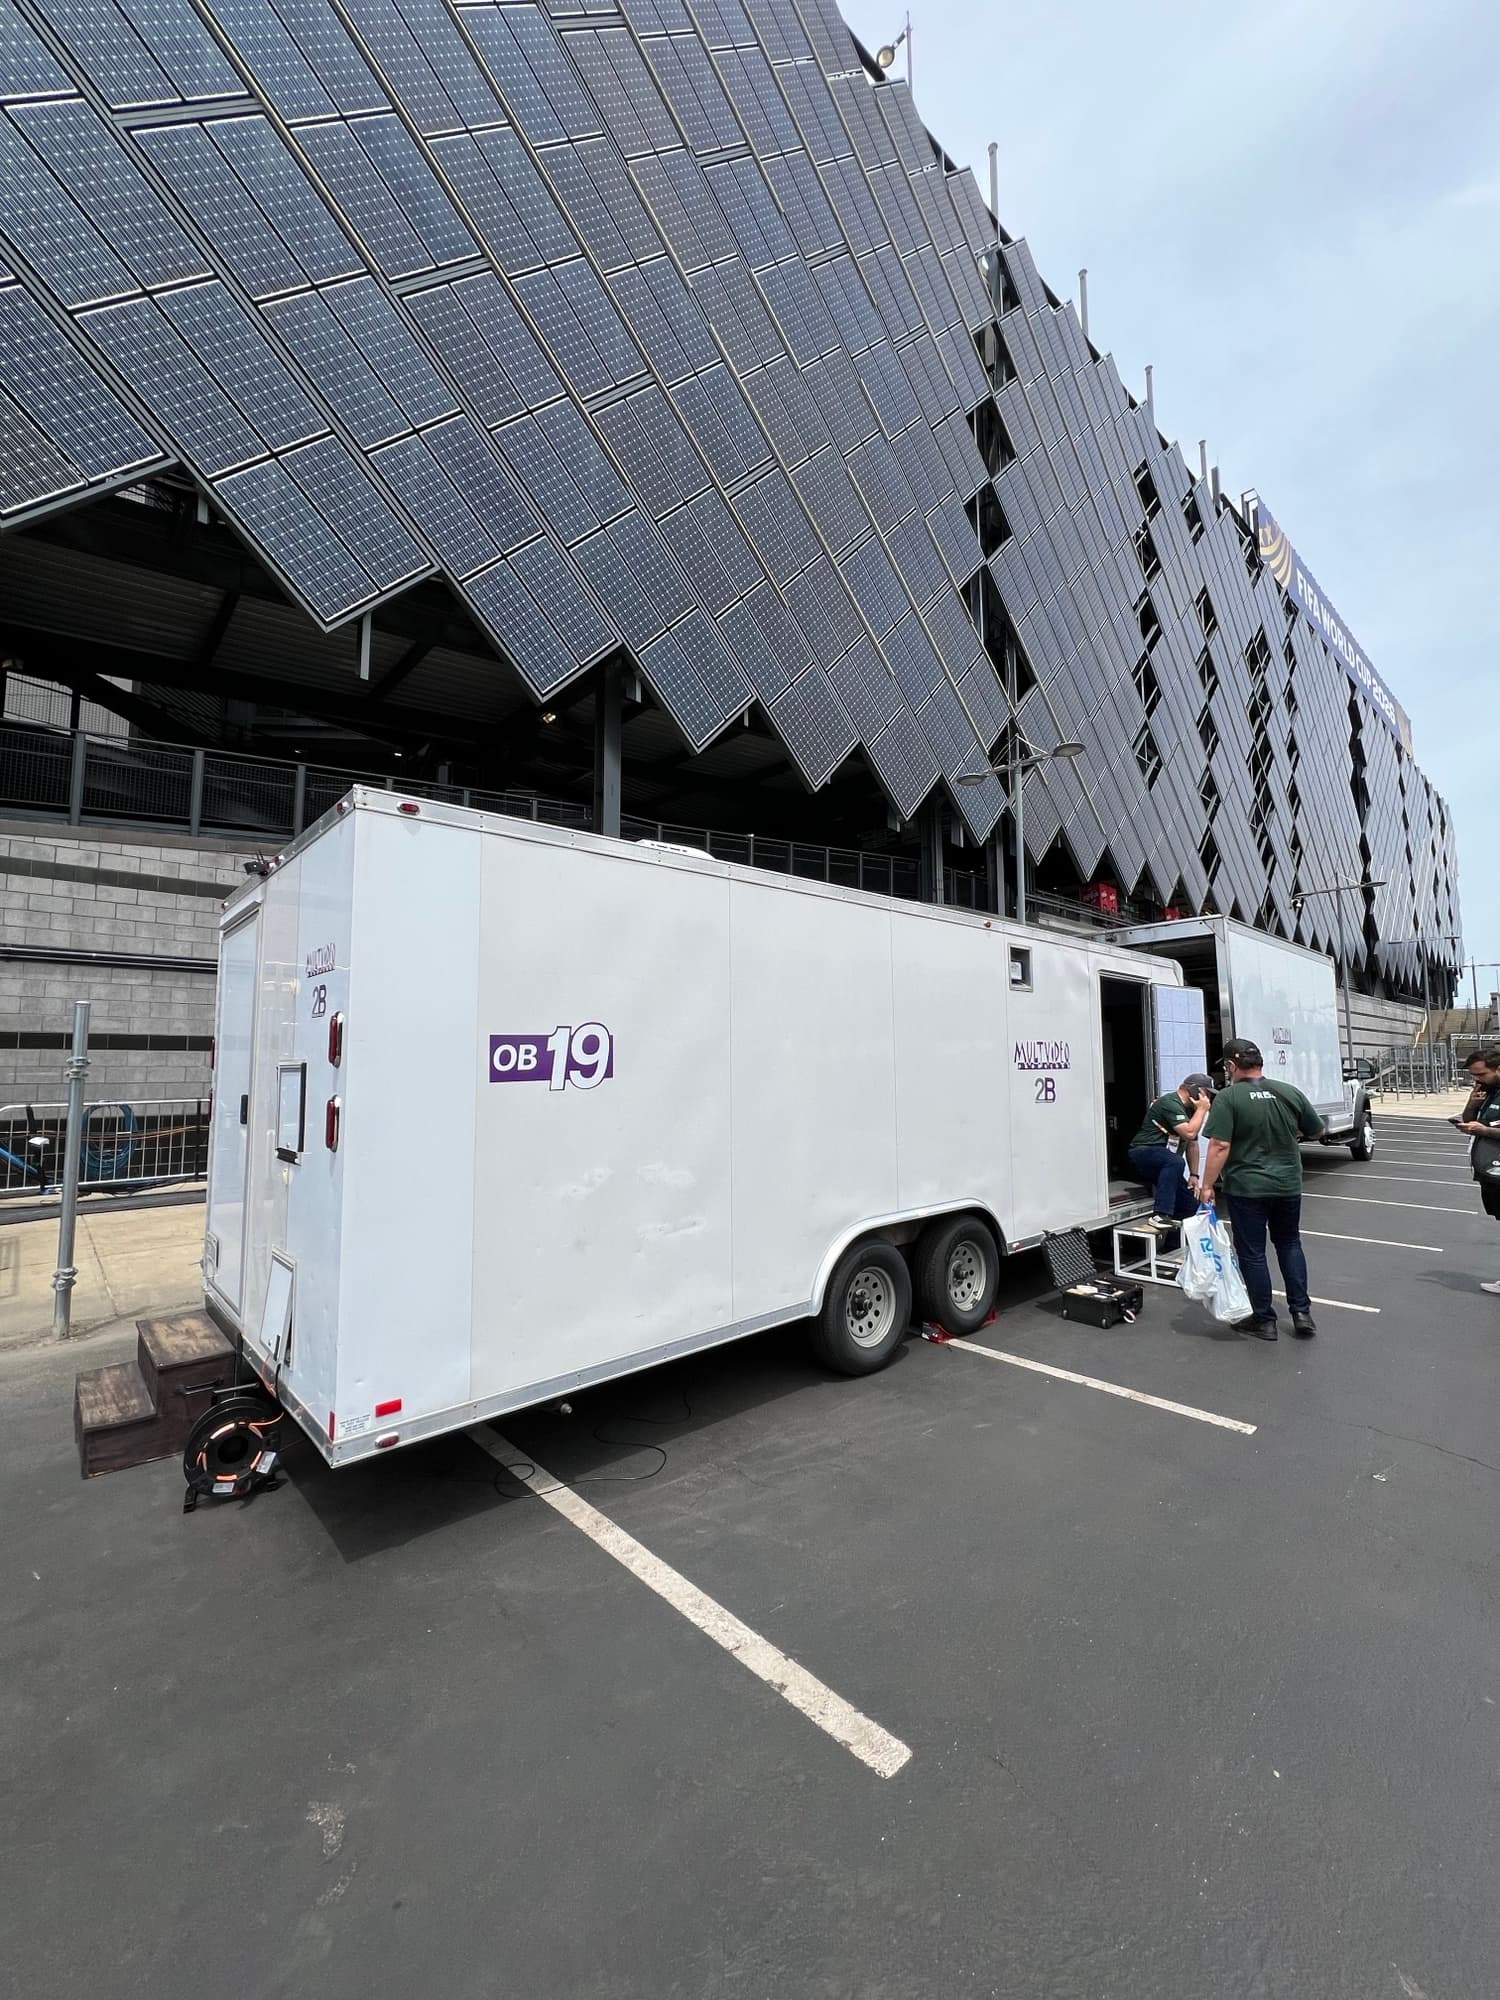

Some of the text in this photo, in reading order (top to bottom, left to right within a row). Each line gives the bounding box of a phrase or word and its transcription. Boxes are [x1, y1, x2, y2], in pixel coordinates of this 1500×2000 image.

[1297, 568, 1321, 624] FIFA
[1321, 603, 1355, 668] WORLD
[1356, 654, 1371, 690] CUP
[311, 984, 327, 1018] 2B
[493, 1021, 611, 1092] OB 19
[1034, 1077, 1056, 1103] 2B
